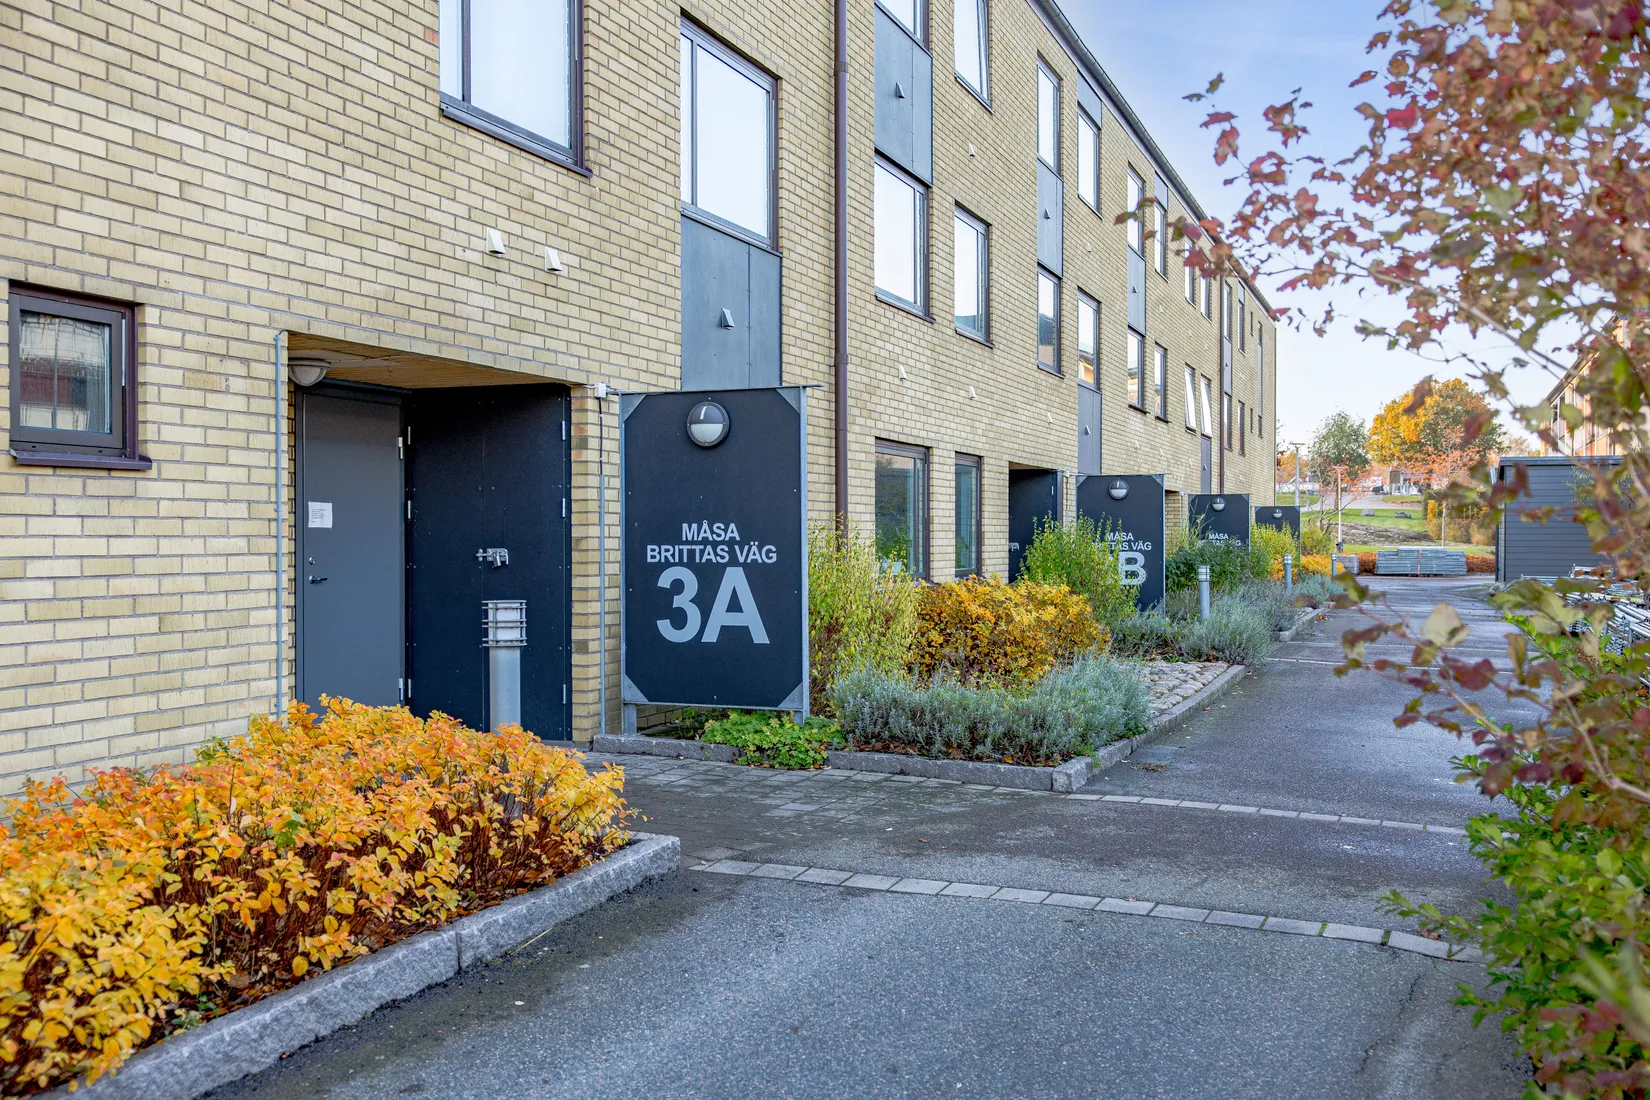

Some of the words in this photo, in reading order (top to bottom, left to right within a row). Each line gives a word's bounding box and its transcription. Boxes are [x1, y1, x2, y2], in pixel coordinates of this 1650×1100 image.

[681, 520, 740, 541] MÅSA
[1106, 531, 1134, 541] MÅSA
[1208, 532, 1229, 540] MÅSA
[646, 545, 730, 563] BRITTAS
[734, 541, 777, 563] VÄG
[1131, 540, 1152, 551] VÄG
[1105, 551, 1147, 586] B
[656, 566, 771, 645] 3A
